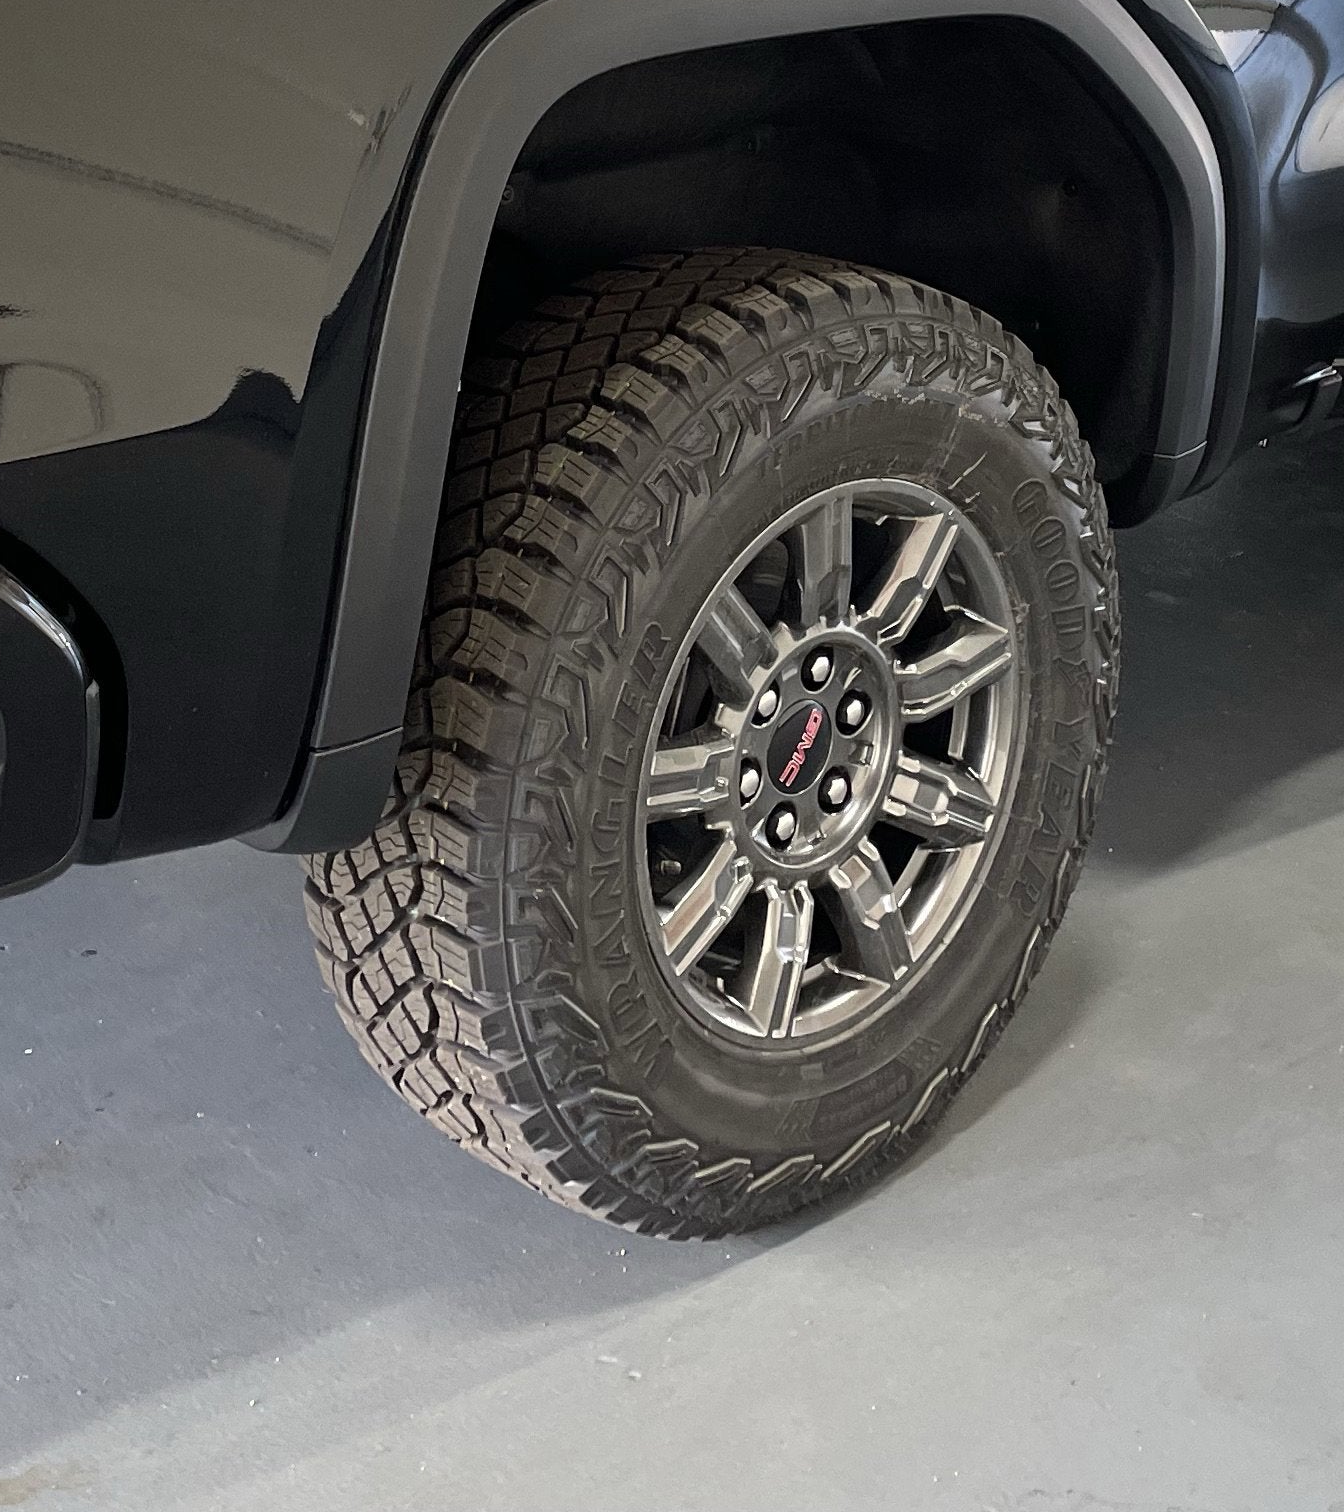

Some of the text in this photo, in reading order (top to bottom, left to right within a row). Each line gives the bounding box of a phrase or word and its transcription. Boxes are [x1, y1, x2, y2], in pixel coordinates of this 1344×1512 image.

[587, 616, 677, 1092] WRANGLER
[776, 705, 823, 777] GMC
[1006, 465, 1091, 921] GOODYEAR
